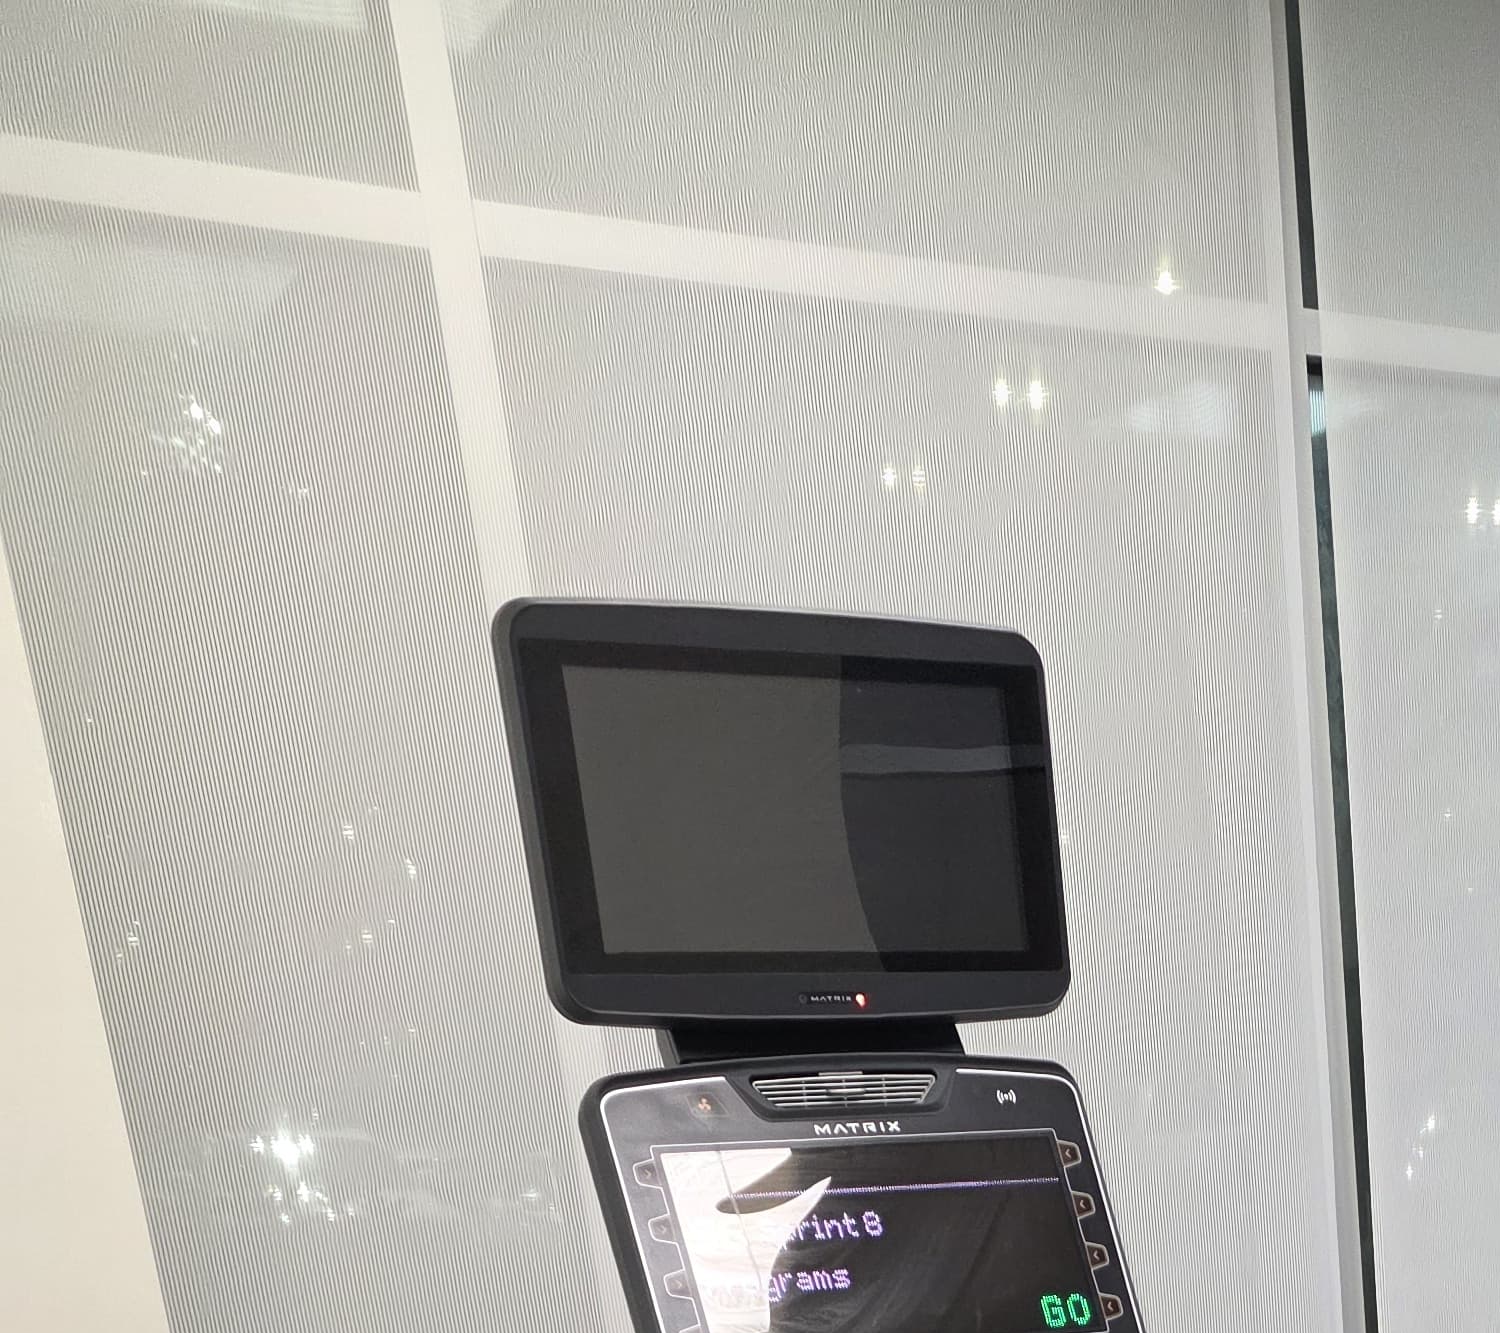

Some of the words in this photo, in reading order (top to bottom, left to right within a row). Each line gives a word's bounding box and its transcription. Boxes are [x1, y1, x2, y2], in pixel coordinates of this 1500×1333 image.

[813, 1120, 901, 1136] MATRIX
[862, 1209, 884, 1237] 8
[1041, 1293, 1091, 1328] GO
